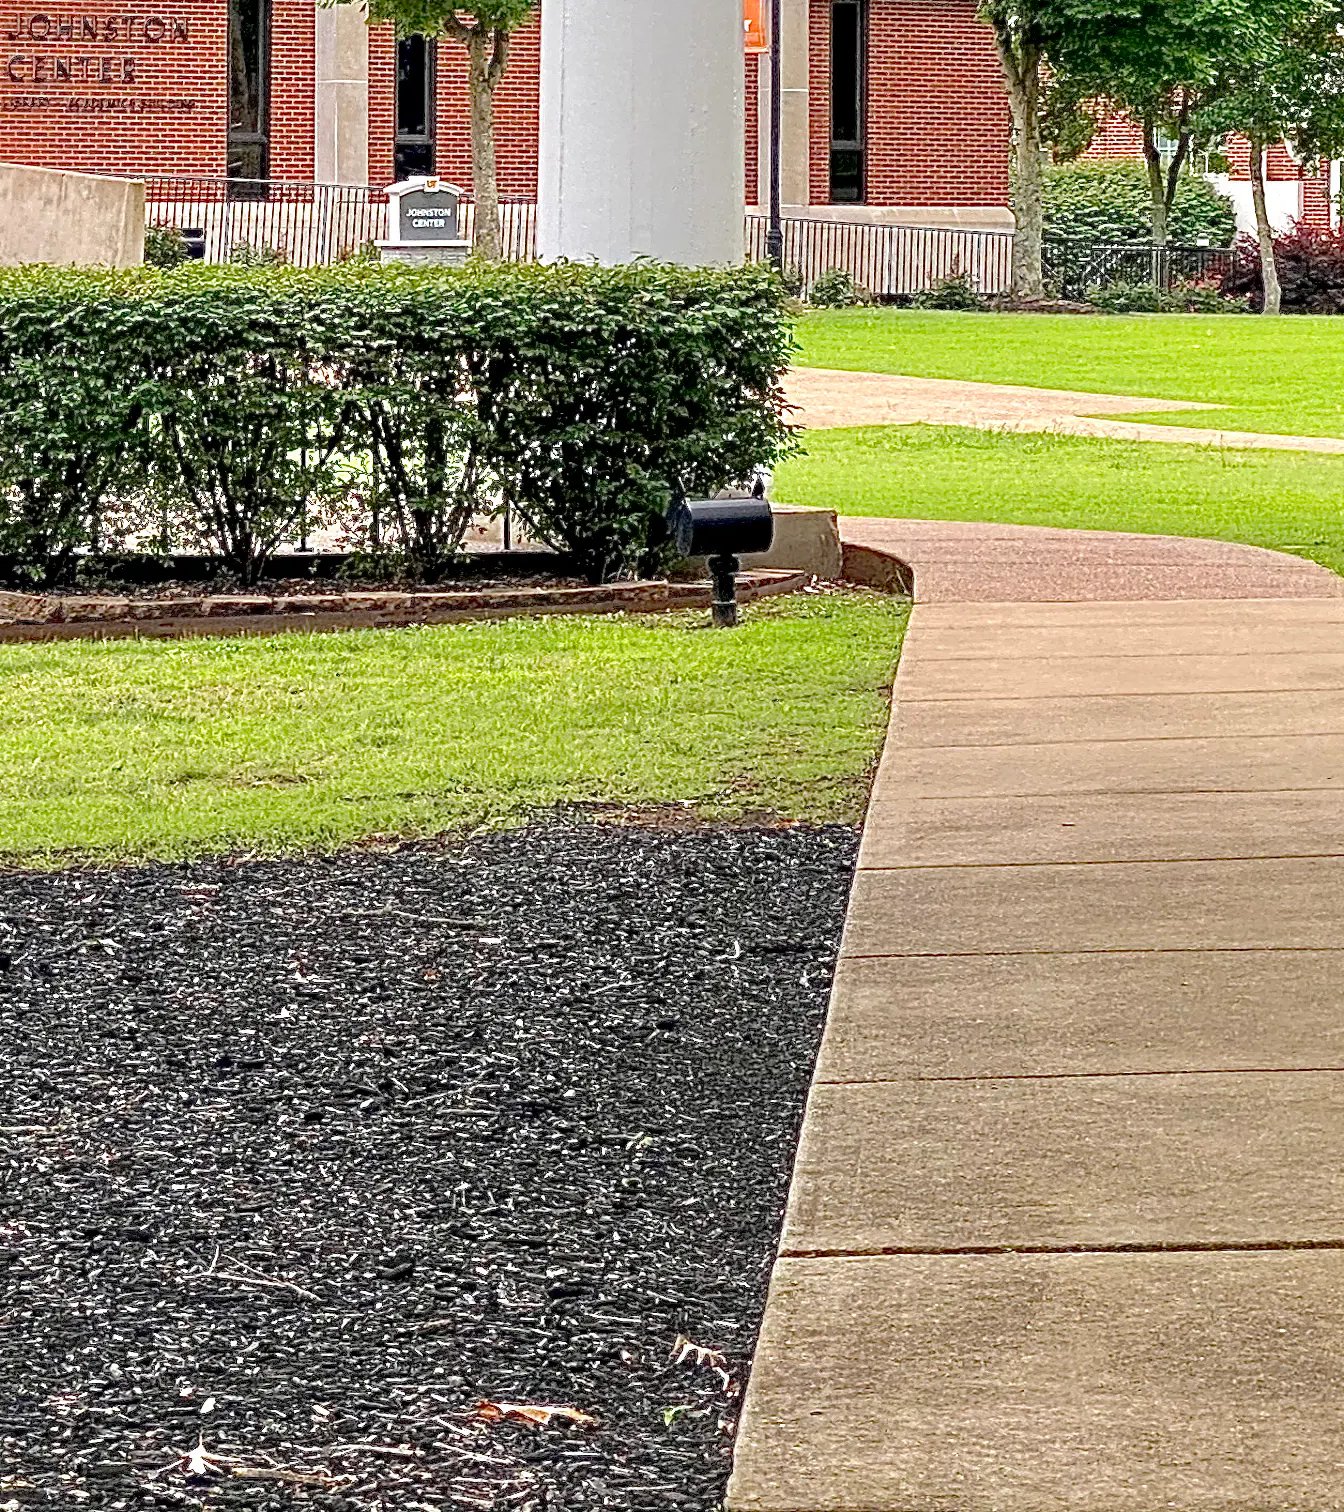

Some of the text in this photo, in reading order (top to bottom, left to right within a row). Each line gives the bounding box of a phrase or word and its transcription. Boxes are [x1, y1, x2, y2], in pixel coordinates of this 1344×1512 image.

[6, 13, 191, 42] JOHNSTON
[7, 55, 136, 85] CENTER
[406, 208, 452, 217] JOHNSTON
[412, 218, 445, 228] CENTER
